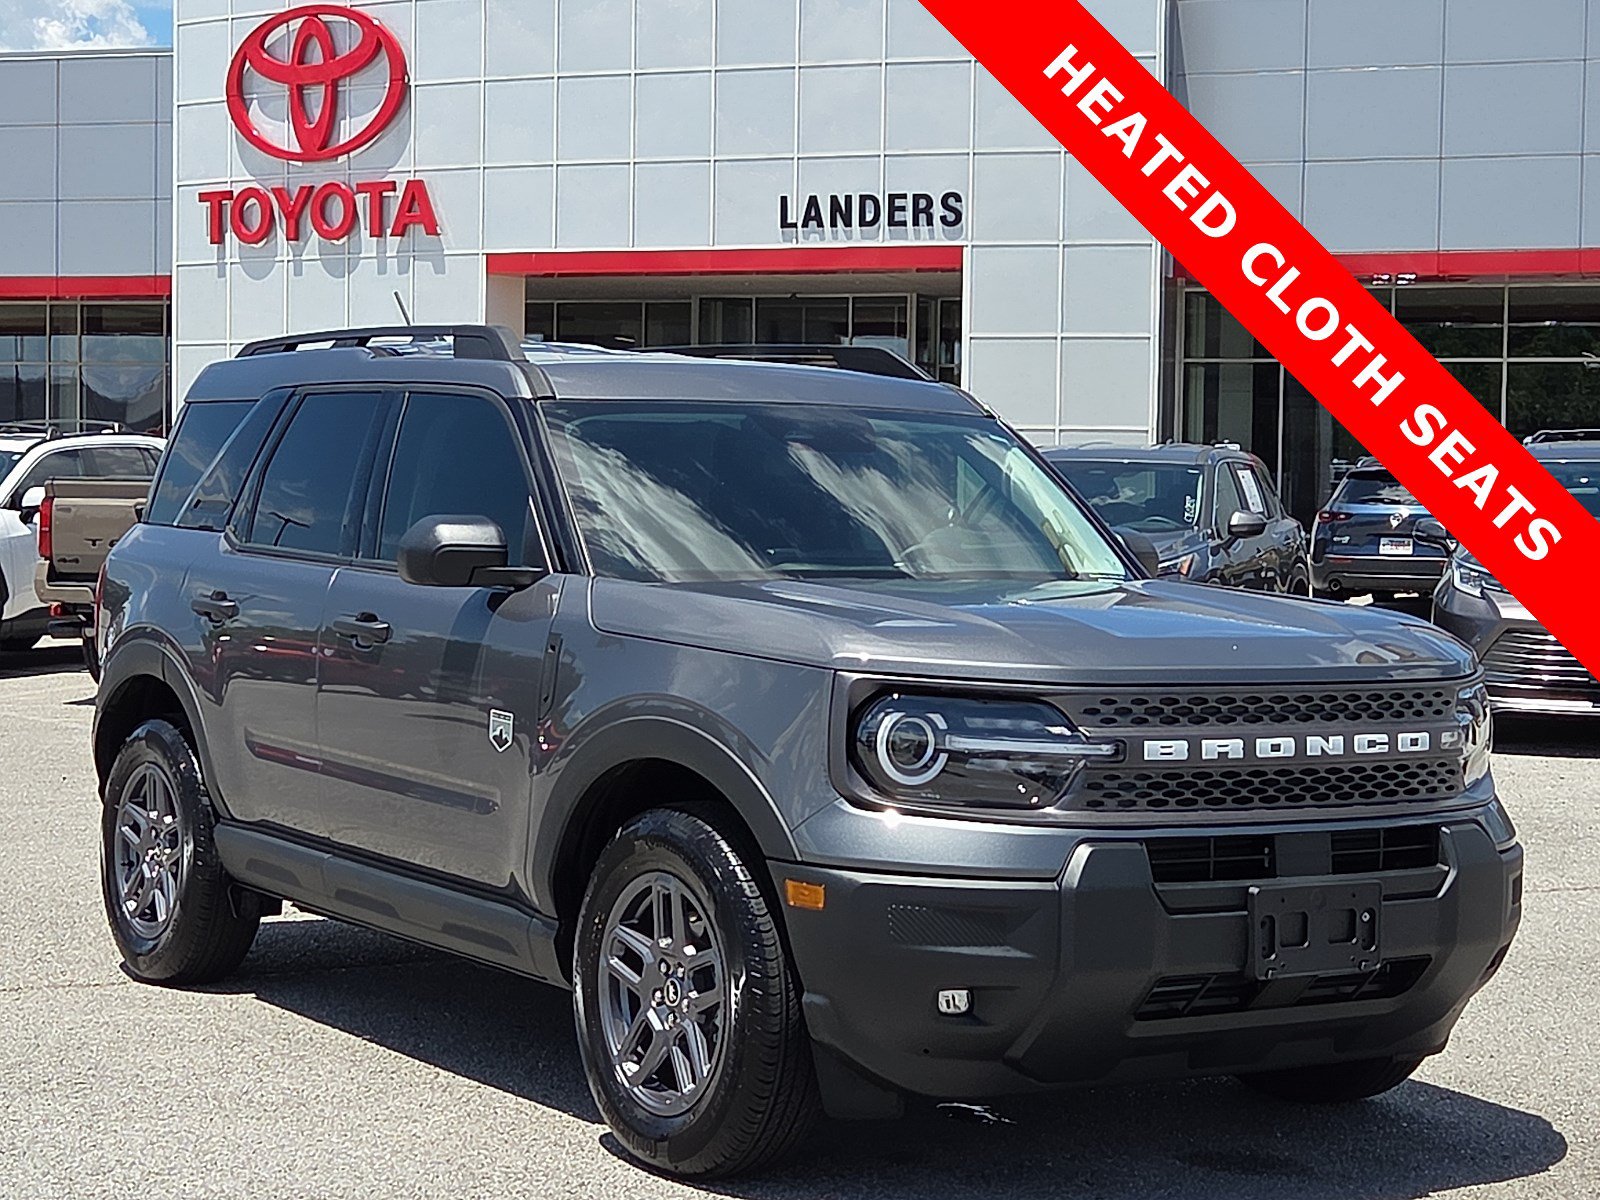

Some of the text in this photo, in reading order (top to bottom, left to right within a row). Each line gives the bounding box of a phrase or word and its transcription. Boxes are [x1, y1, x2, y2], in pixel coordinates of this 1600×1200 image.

[199, 179, 440, 245] TOYOTA
[779, 191, 963, 229] LANDERS
[1143, 732, 1430, 761] BRONCO
